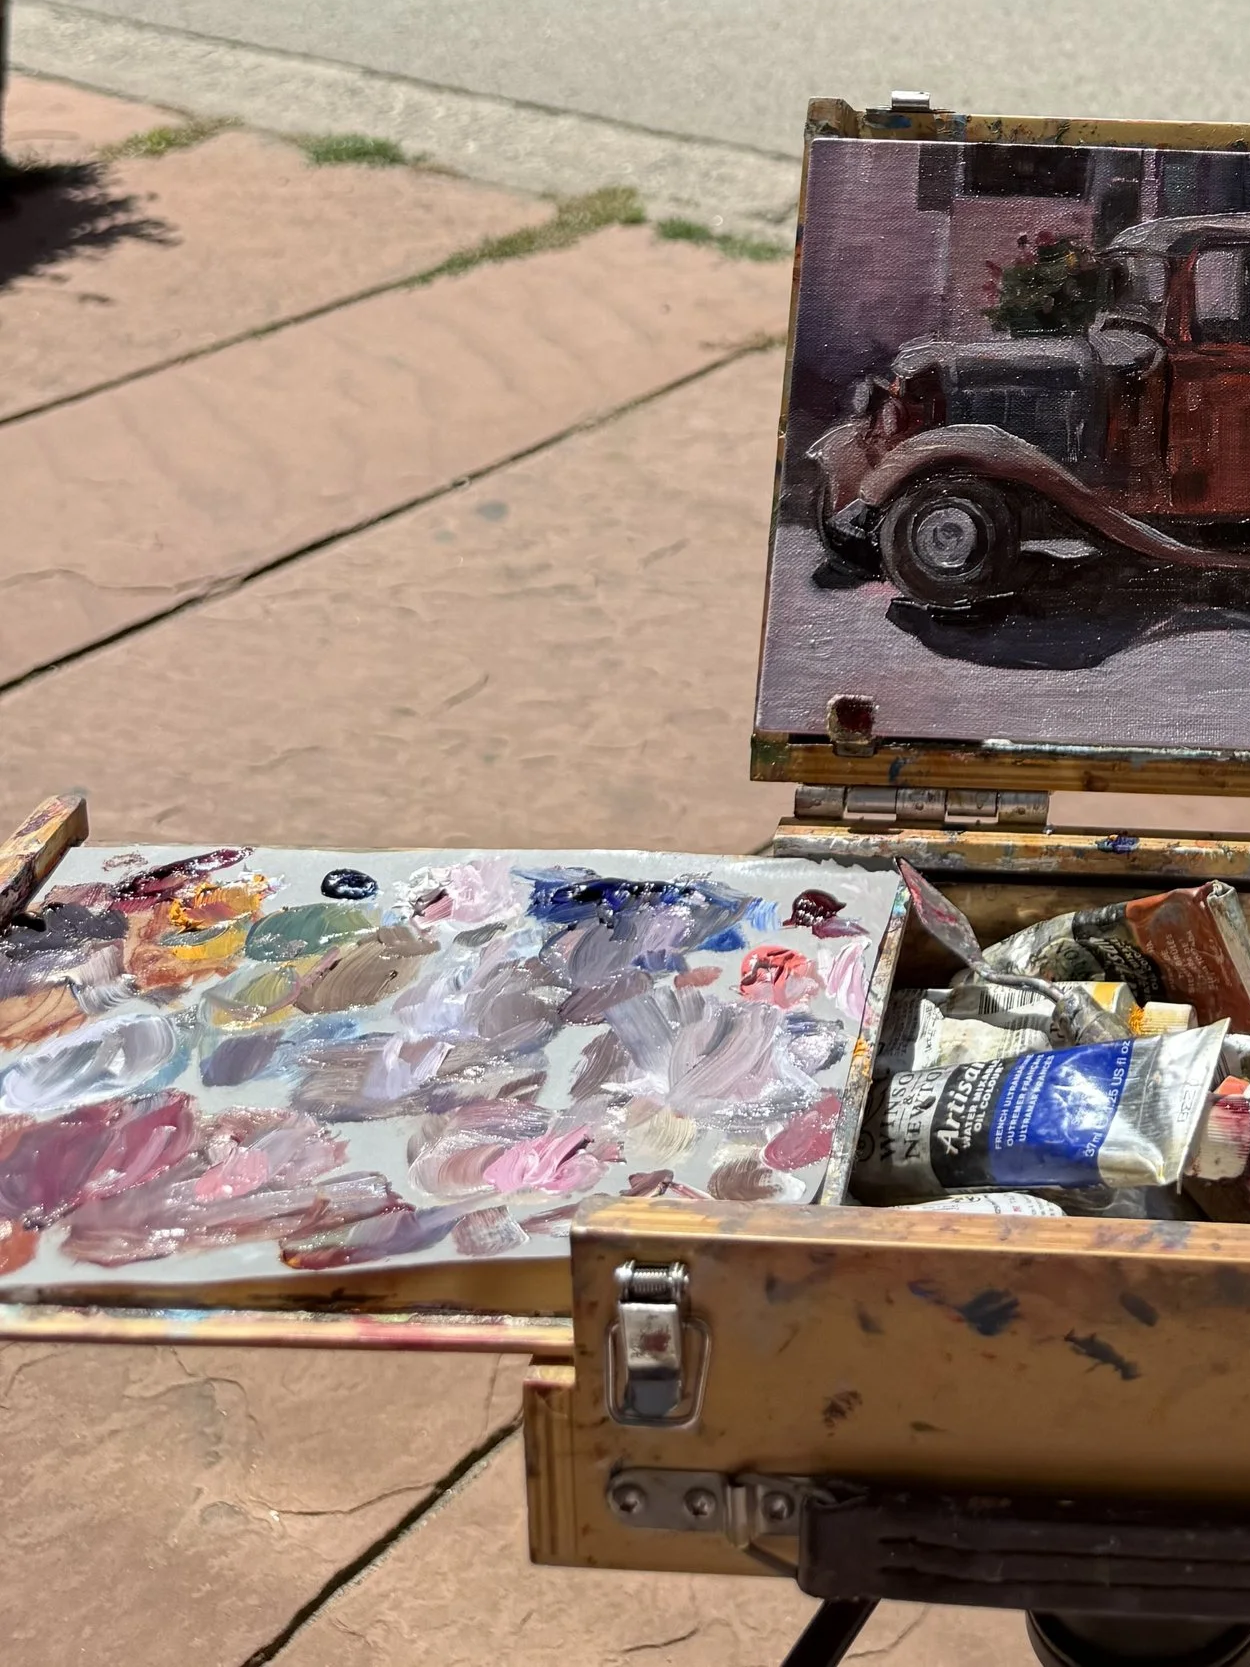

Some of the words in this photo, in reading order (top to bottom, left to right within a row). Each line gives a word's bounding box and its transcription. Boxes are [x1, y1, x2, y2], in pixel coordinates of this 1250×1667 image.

[1110, 1067, 1125, 1086] US
[1119, 1039, 1132, 1054] oz
[880, 1072, 915, 1163] WINSO
[904, 1069, 943, 1160] NEWTO
[961, 1105, 985, 1149] WATER
[972, 1110, 988, 1133] OIL
[994, 1109, 1011, 1150] FRENCH
[1006, 1093, 1031, 1147] OUTREMER
[1018, 1092, 1042, 1142] ULTRAMAR
